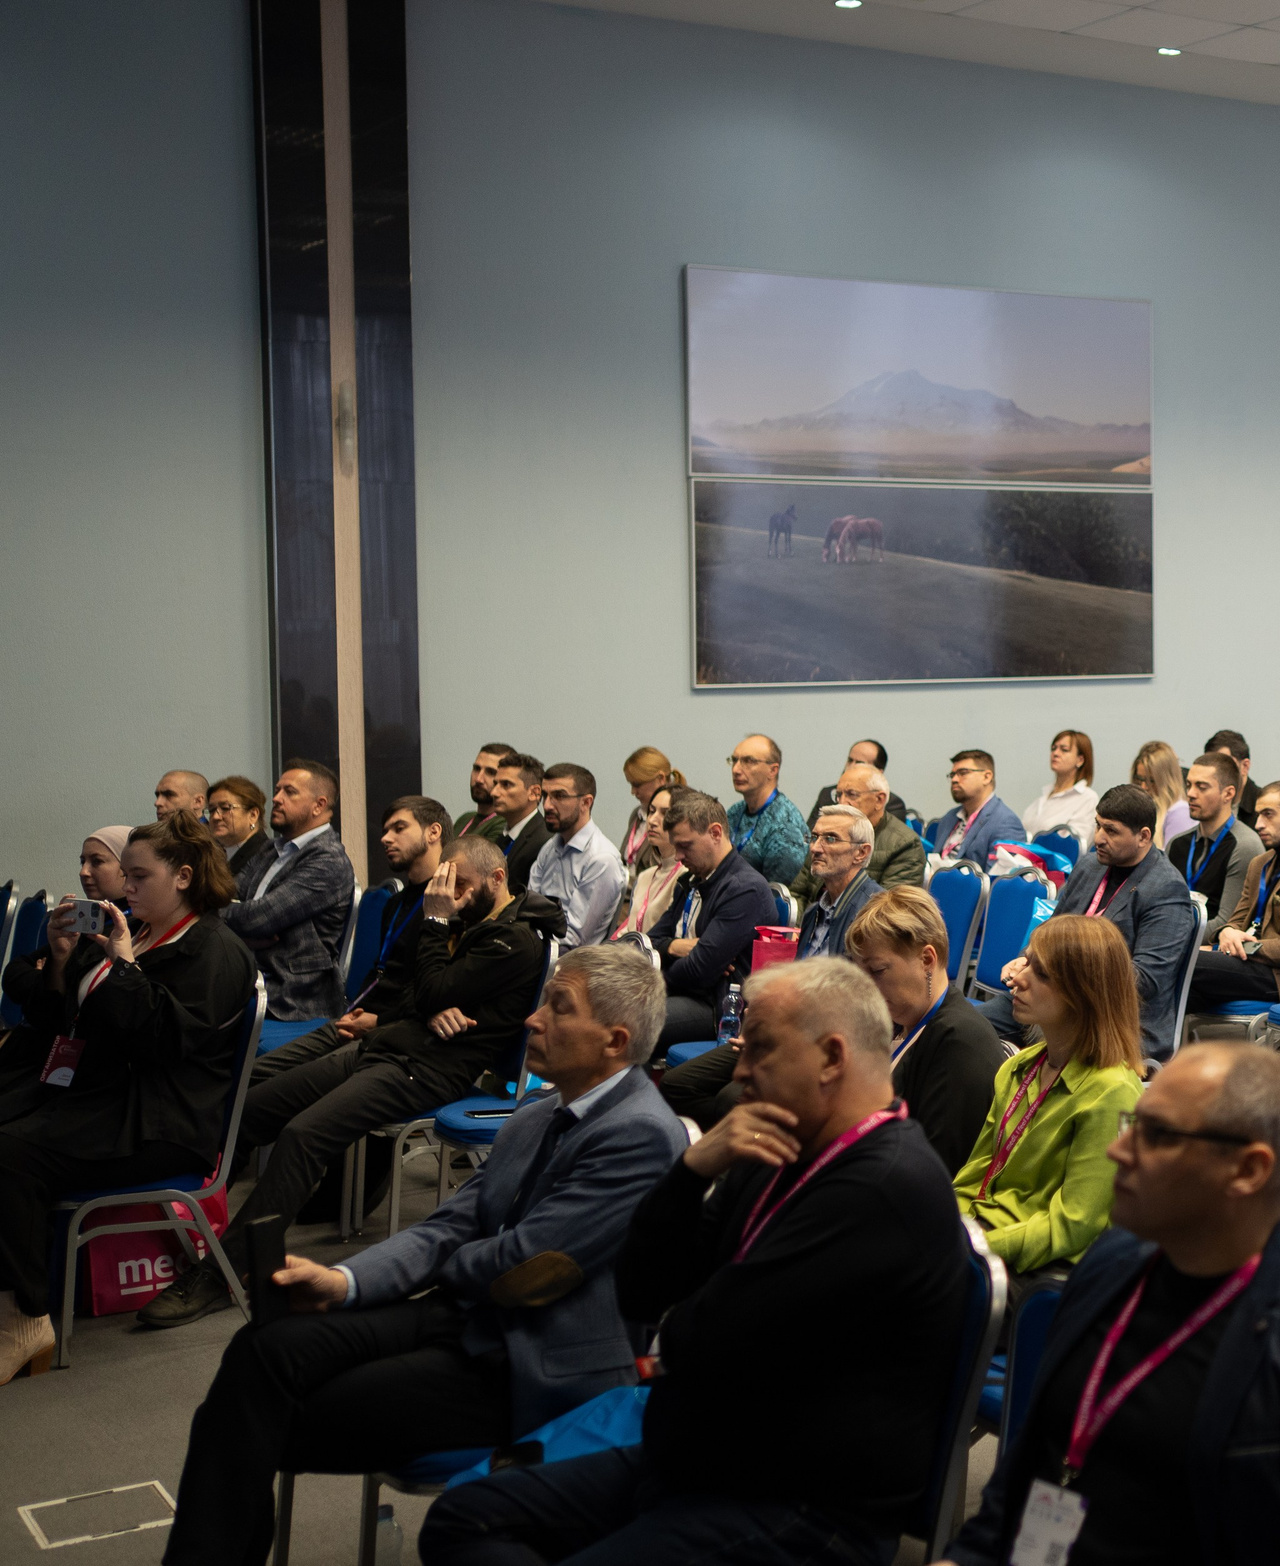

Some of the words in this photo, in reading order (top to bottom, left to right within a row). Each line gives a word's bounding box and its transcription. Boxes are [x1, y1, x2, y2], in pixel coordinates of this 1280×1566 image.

[40, 1035, 60, 1081] ОРГАНИЗАТОР
[1006, 1100, 1018, 1117] medi.
[1018, 1084, 1027, 1097] feel
[1006, 1134, 1018, 1151] medi.
[1017, 1119, 1027, 1131] feel
